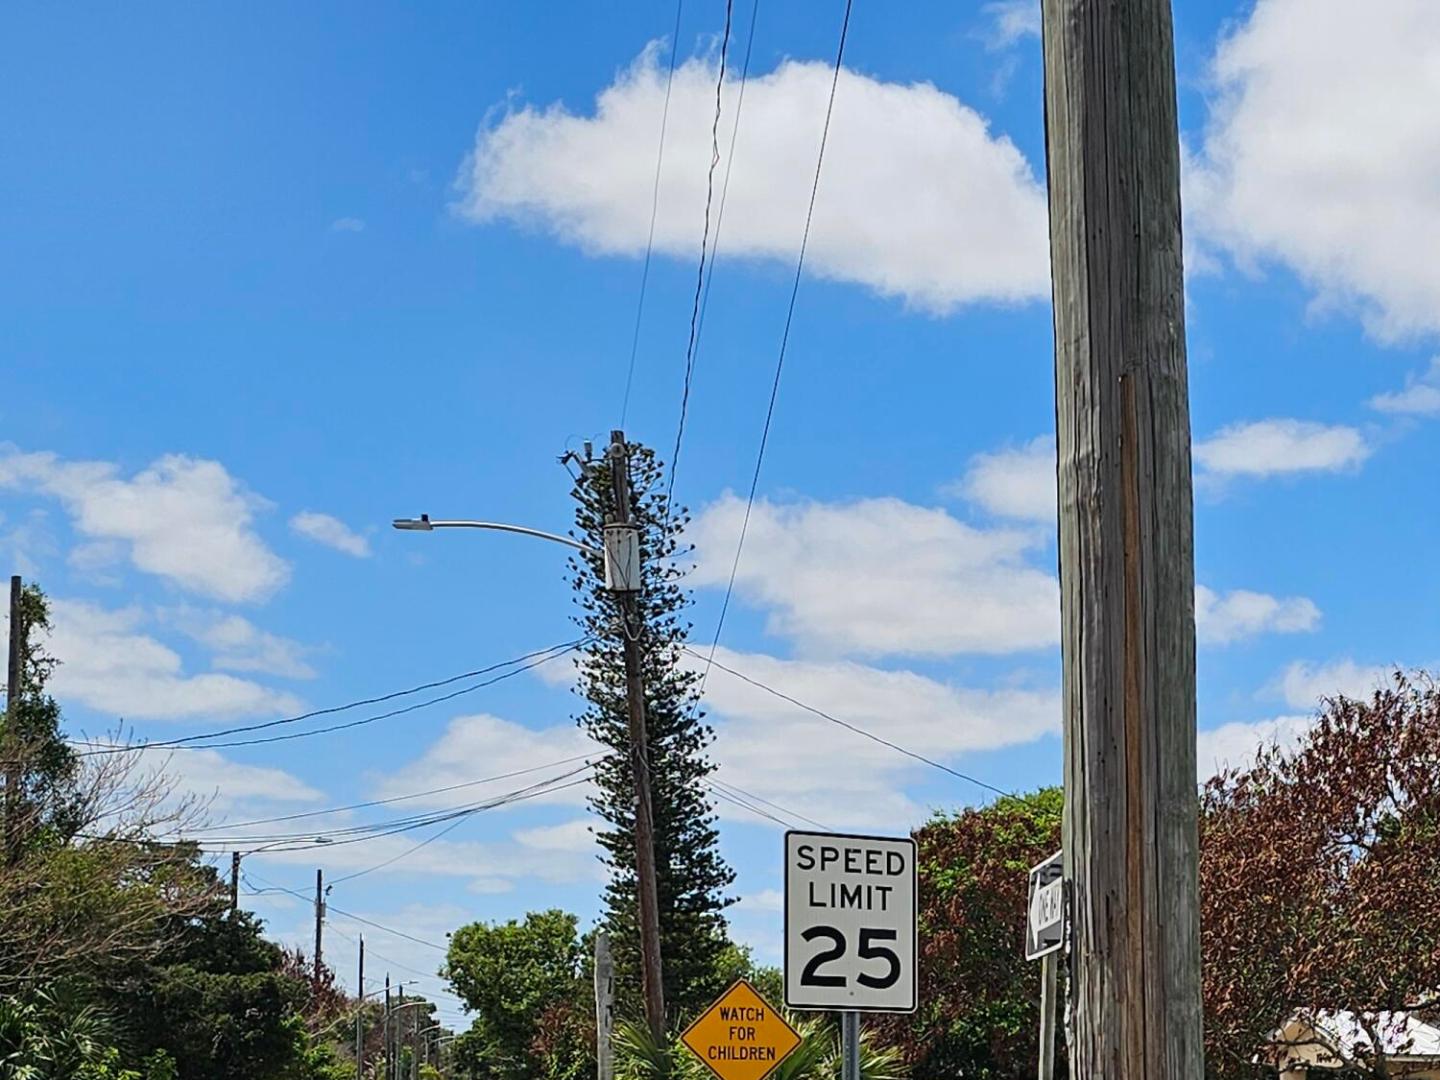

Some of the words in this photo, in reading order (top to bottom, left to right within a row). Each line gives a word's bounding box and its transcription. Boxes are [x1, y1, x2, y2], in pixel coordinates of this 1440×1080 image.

[796, 845, 905, 876] SPEED
[808, 881, 893, 911] LIMIT
[800, 925, 901, 990] 25
[719, 1006, 765, 1022] WATCH
[728, 1026, 756, 1041] FOR
[707, 1045, 776, 1061] CHILDREN
